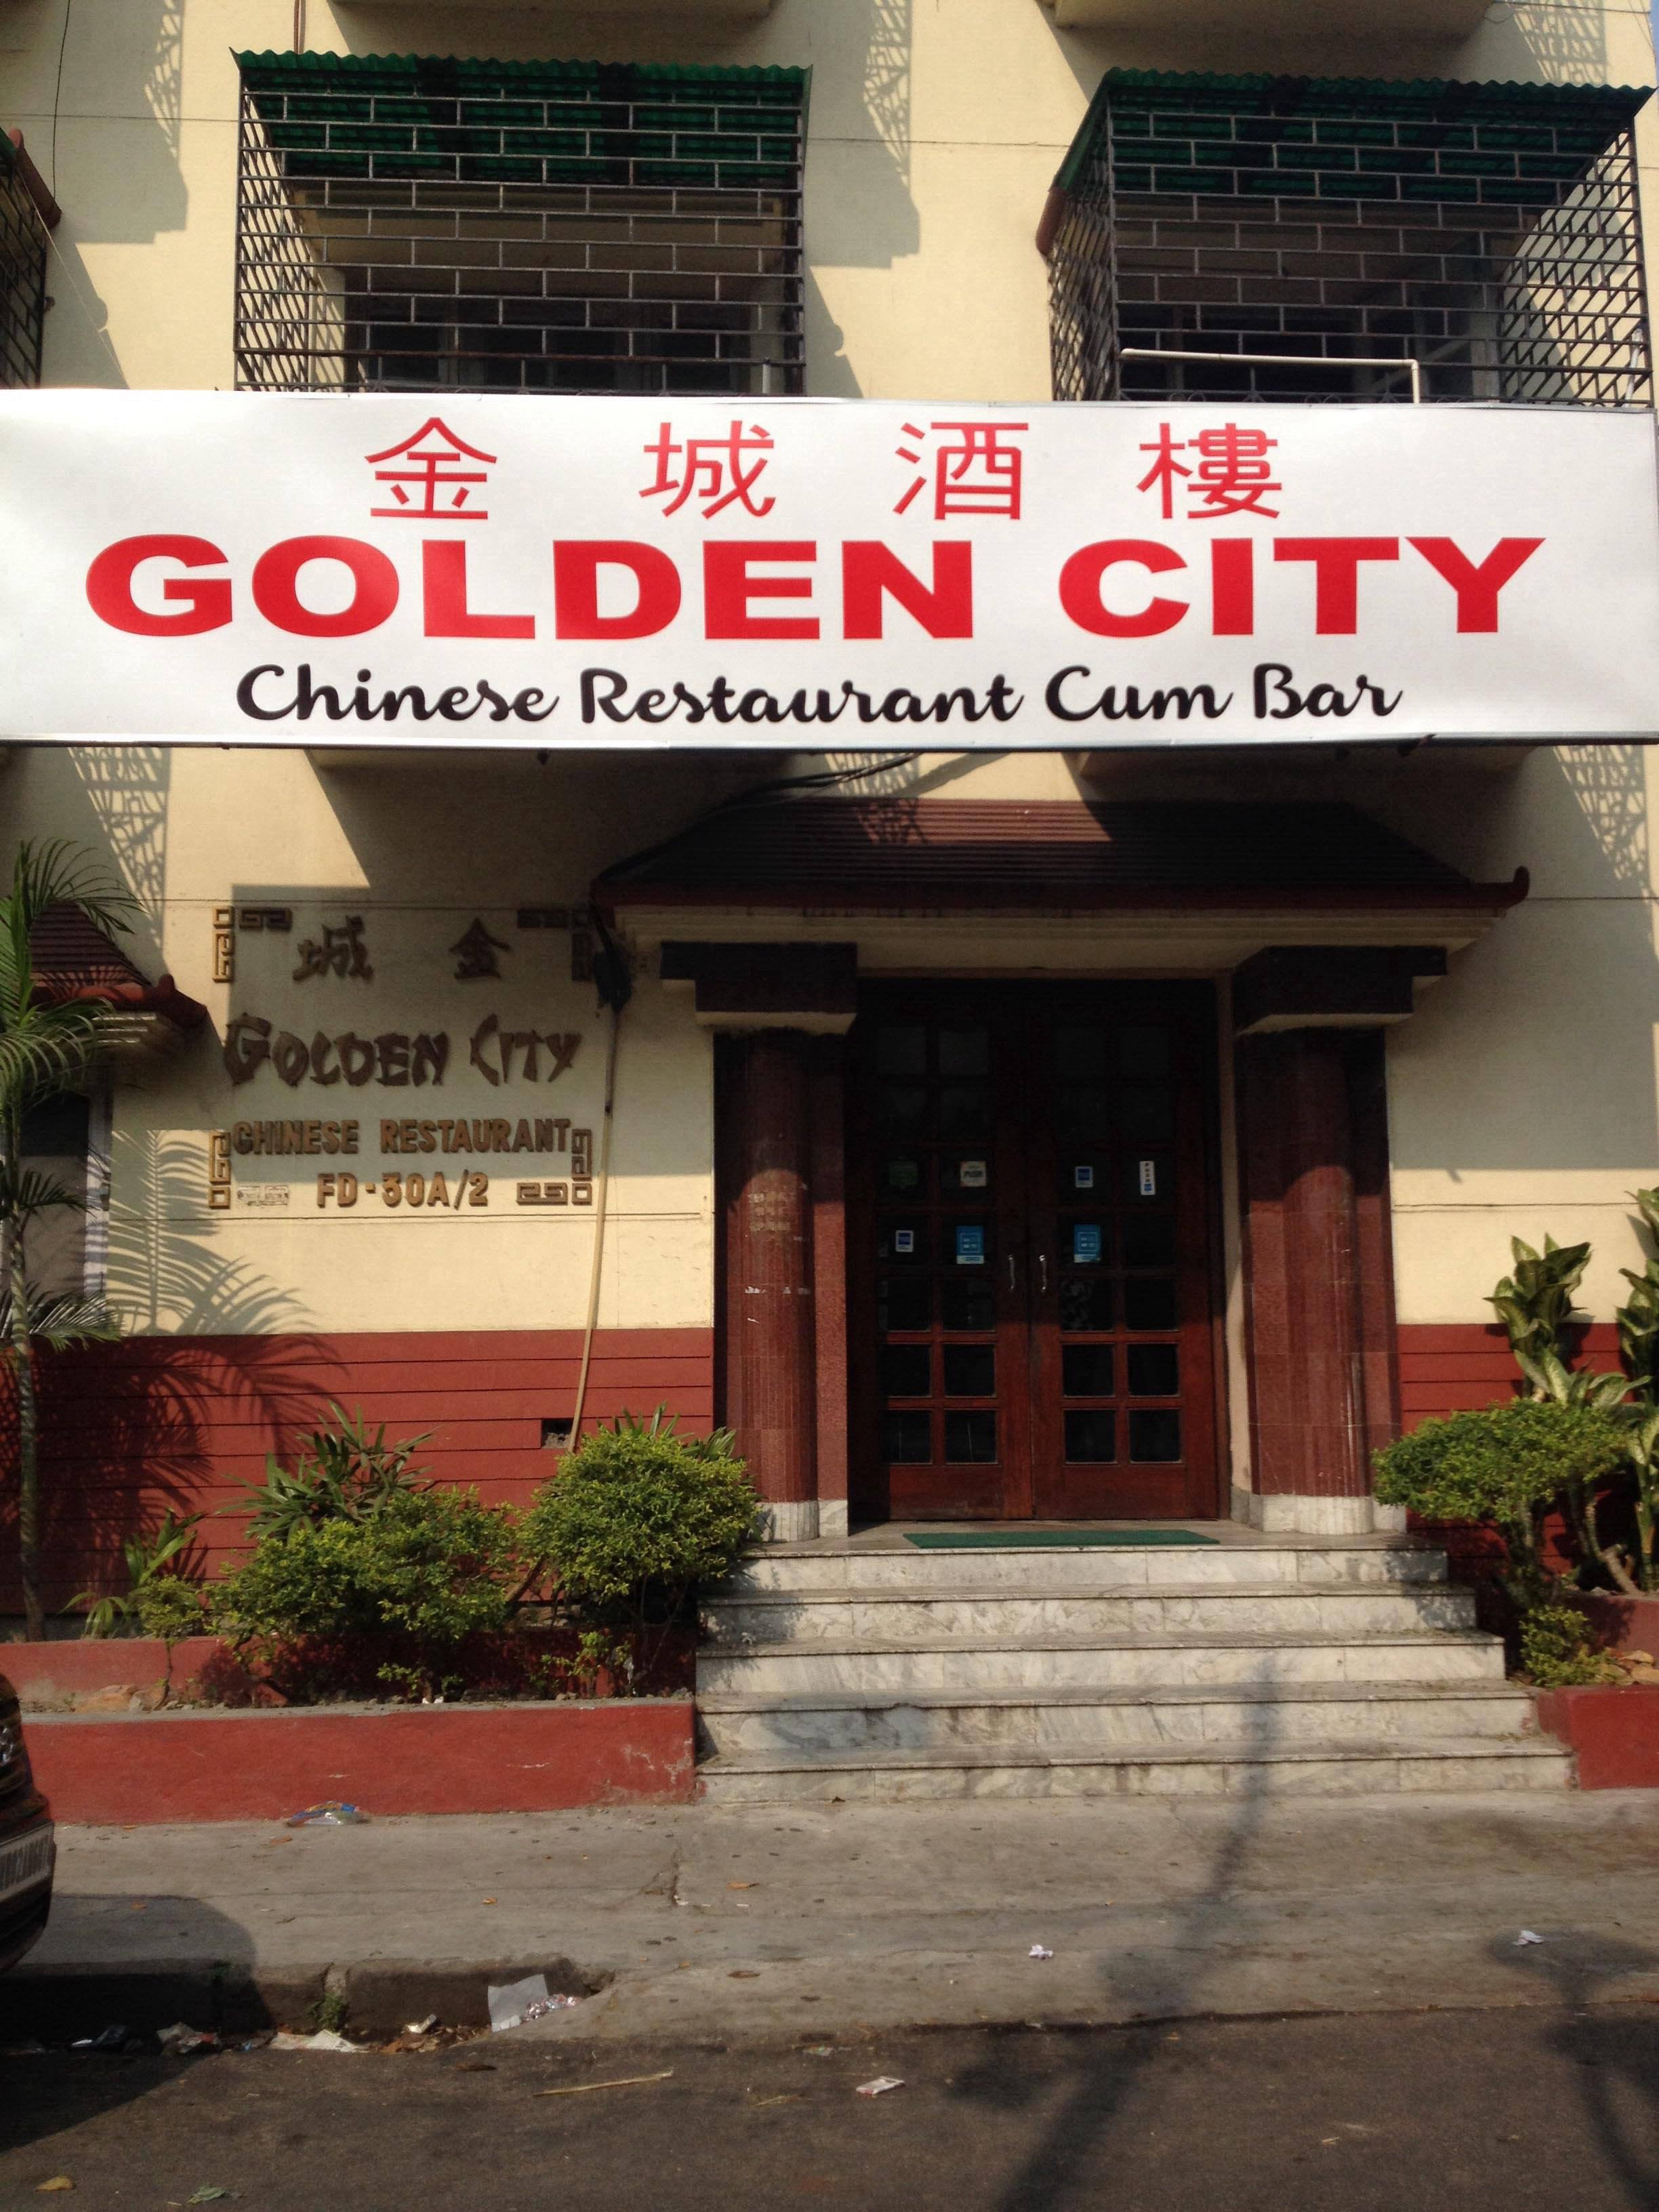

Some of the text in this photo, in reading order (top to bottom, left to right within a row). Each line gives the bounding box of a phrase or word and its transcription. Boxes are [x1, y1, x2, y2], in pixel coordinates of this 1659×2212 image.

[367, 417, 1282, 521] 金城酒樓
[85, 533, 1546, 641] GOLDEN CITY
[237, 662, 1403, 724] Chinese Restaurant Cum Bar
[232, 1118, 571, 1154] CHINESE RESTAURANT
